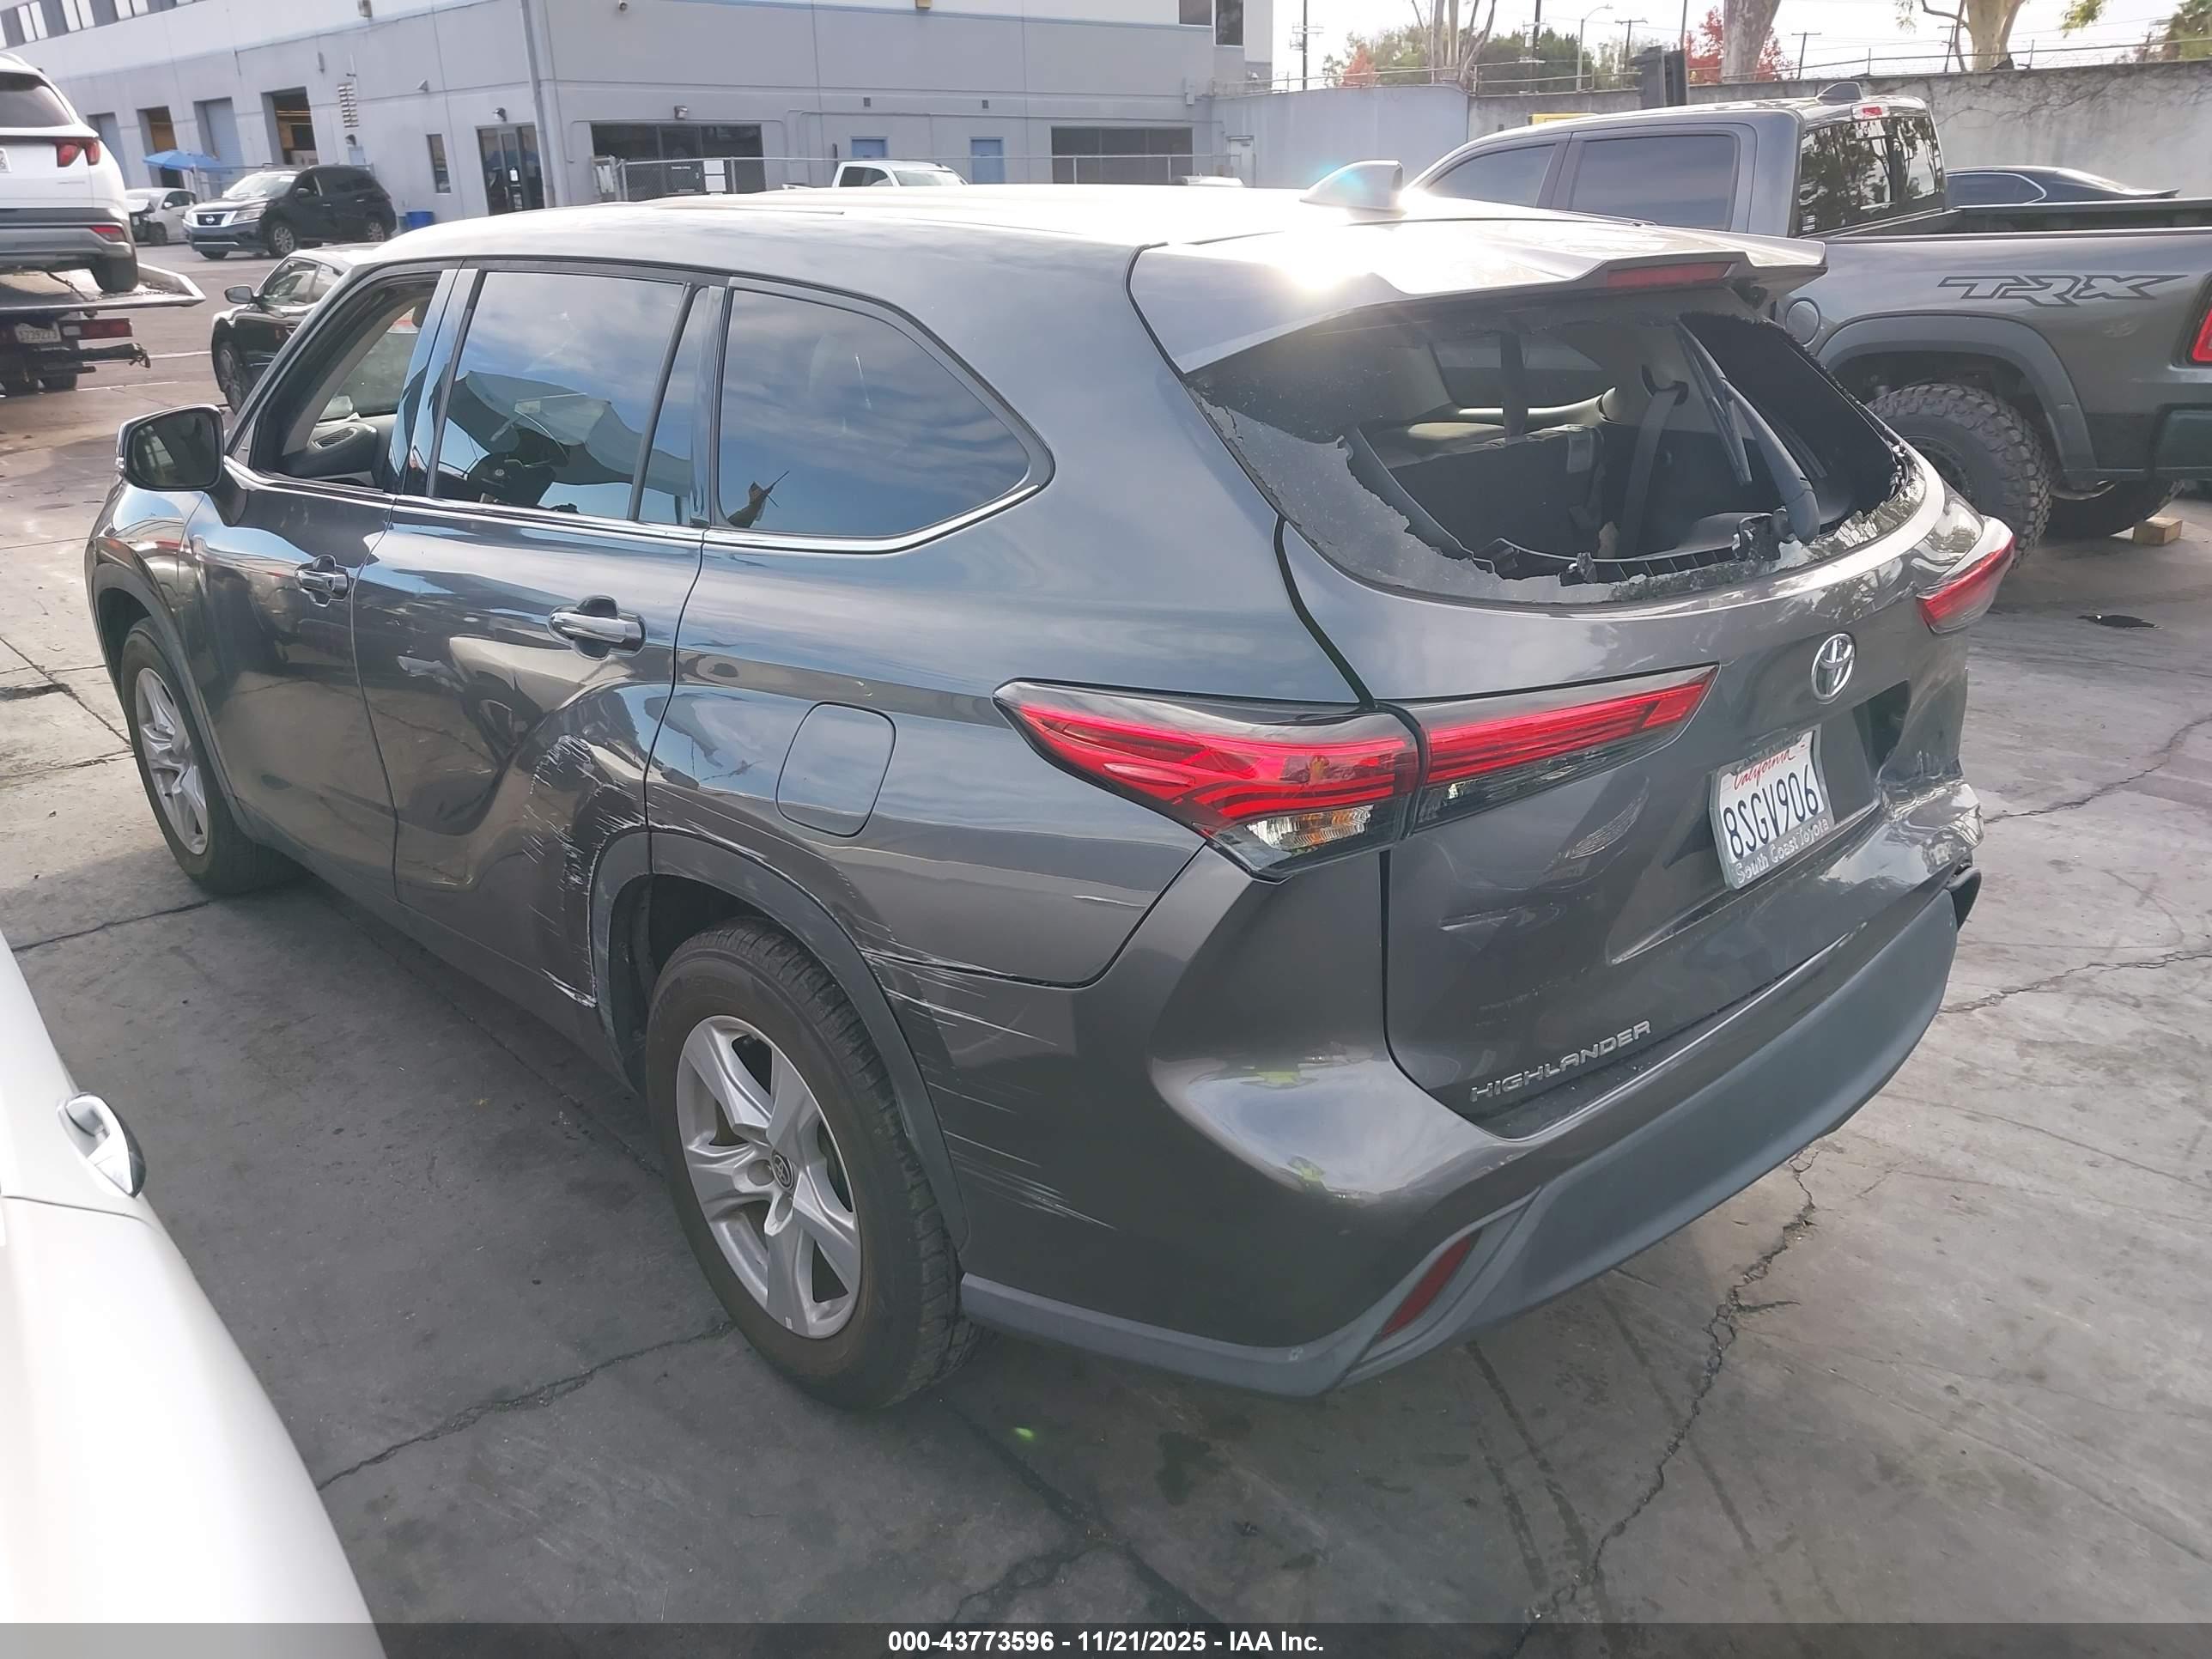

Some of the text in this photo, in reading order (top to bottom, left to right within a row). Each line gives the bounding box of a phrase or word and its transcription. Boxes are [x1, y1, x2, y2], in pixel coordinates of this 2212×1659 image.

[1937, 274, 2190, 307] TRX
[1733, 747, 1797, 791] California
[1723, 763, 1820, 860] 8SGV906
[1735, 817, 1830, 884] South Coast Toyota
[1469, 1019, 1652, 1103] HIGHLANDER
